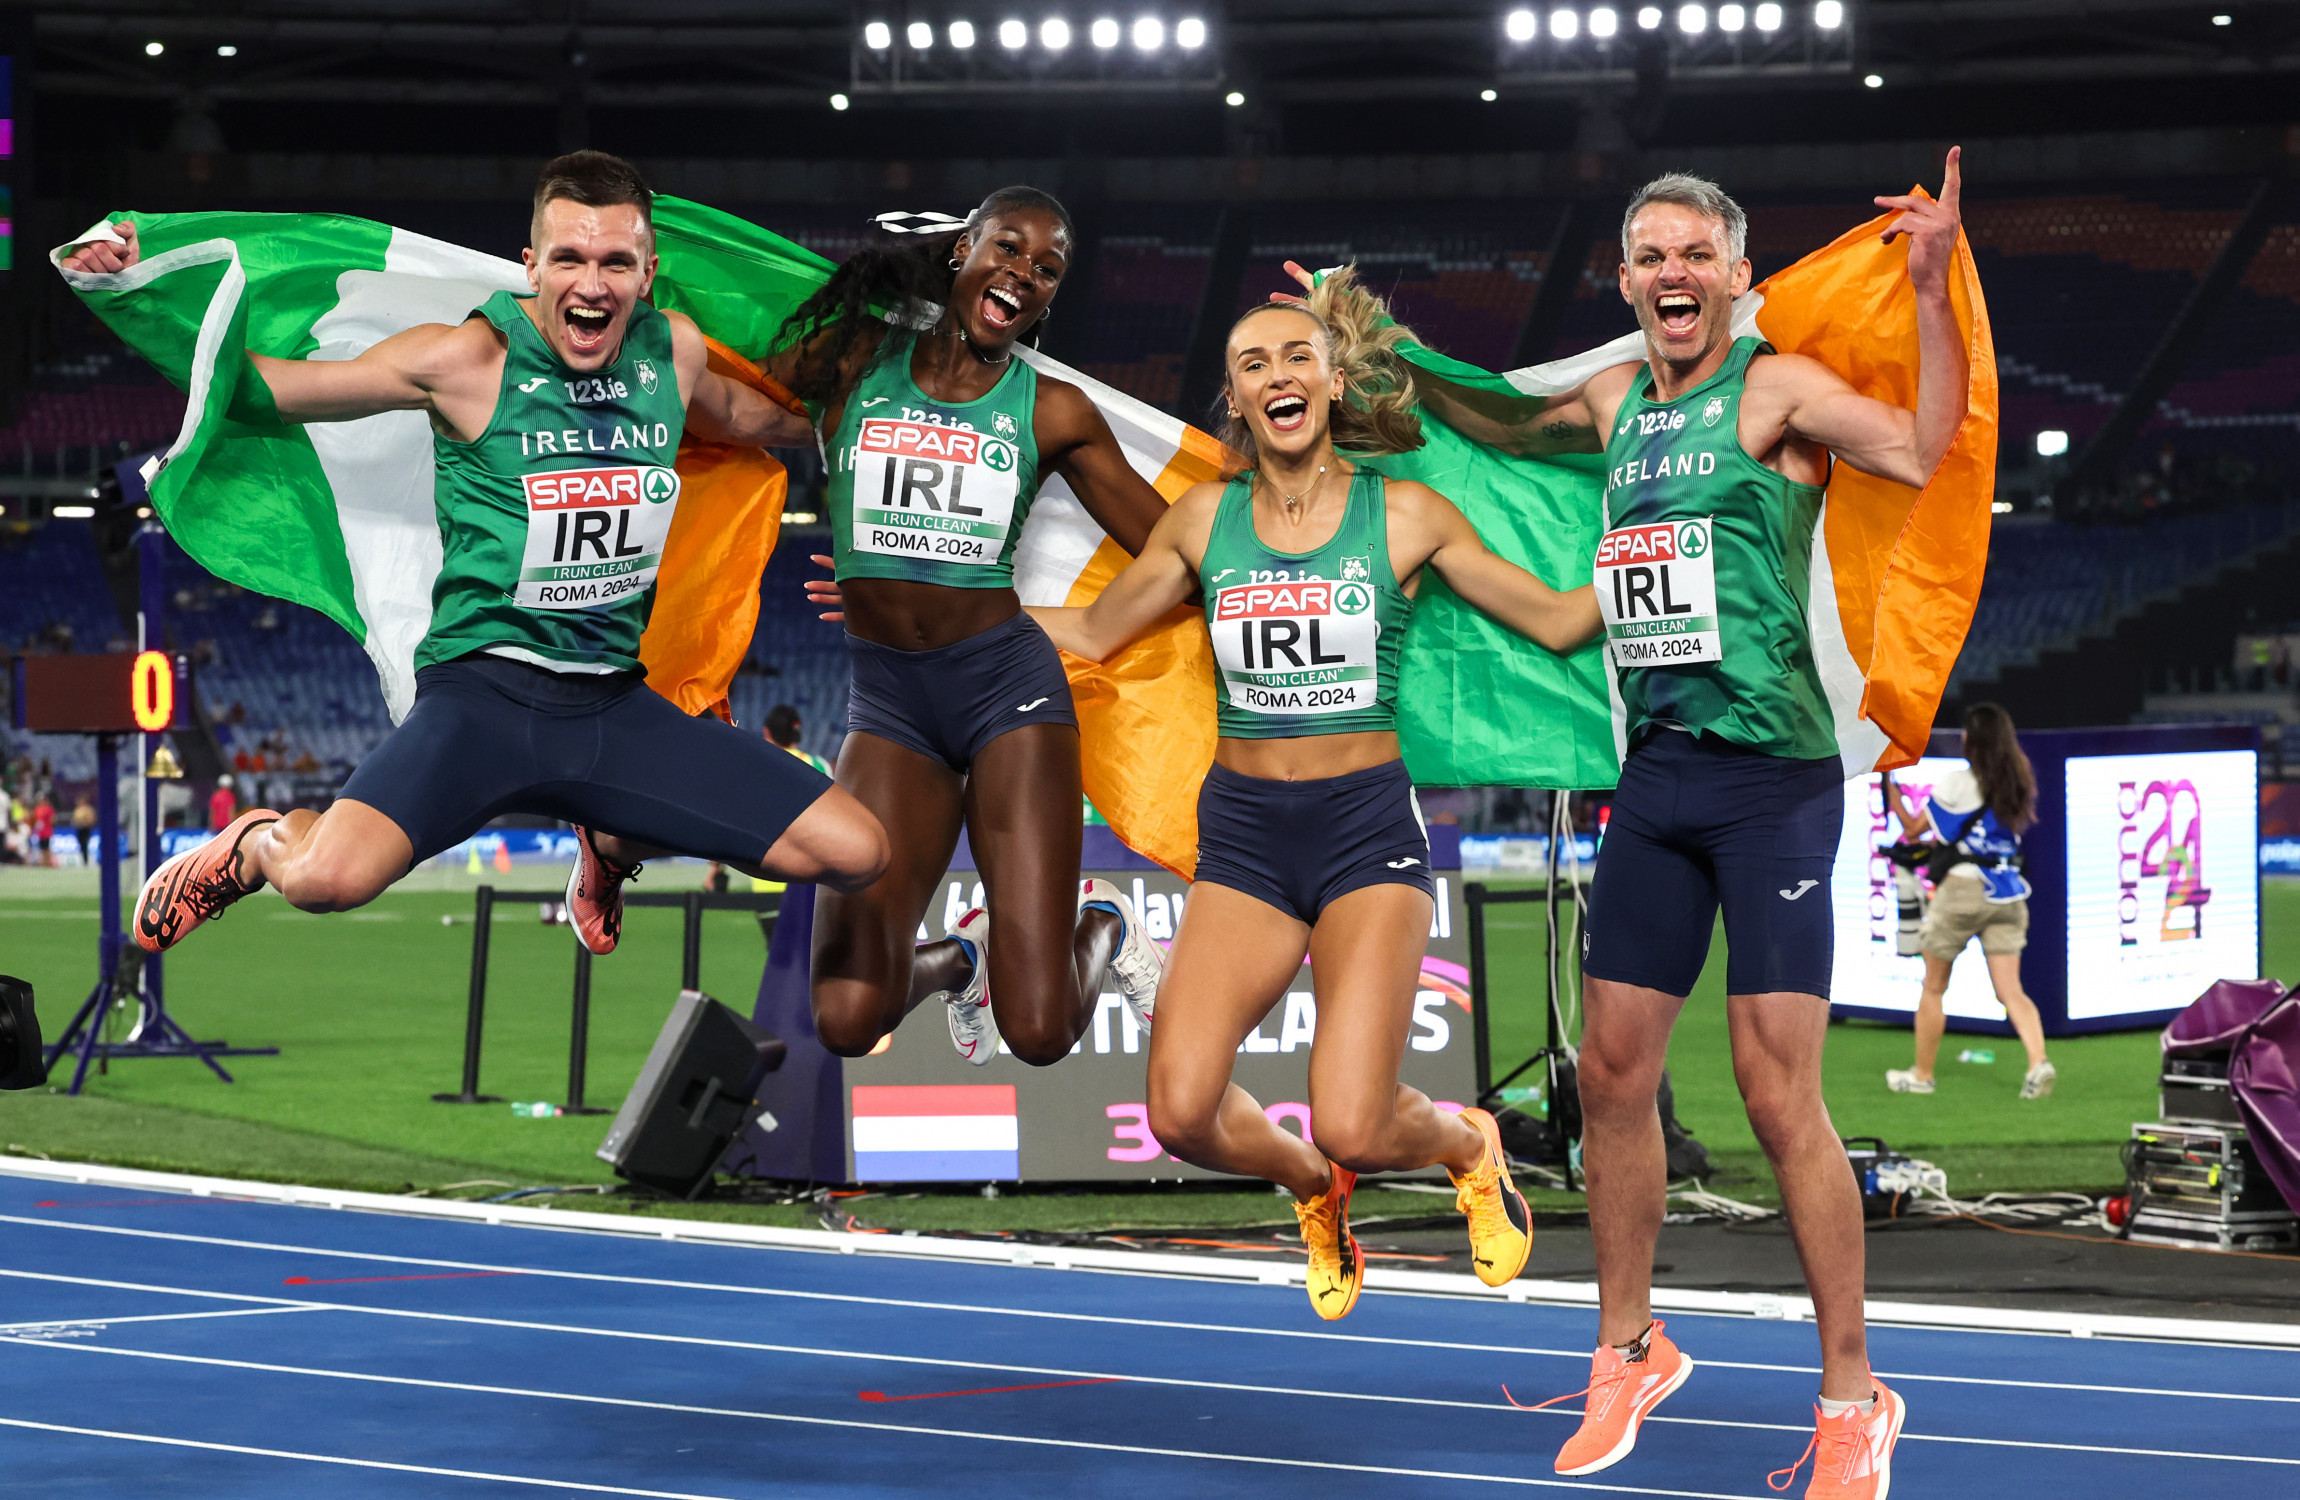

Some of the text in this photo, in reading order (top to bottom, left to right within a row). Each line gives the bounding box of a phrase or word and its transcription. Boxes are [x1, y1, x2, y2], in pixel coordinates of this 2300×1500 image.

[564, 377, 629, 403] 123.ie
[1637, 409, 1686, 436] 123.ie
[521, 423, 669, 455] IRELAND
[865, 425, 976, 460] SPAR
[882, 456, 983, 517] IRL
[1608, 452, 1716, 493] IRELAND
[531, 474, 638, 505] SPAR
[883, 512, 888, 524] I
[890, 513, 923, 528] RUN
[553, 509, 643, 562] IRL
[872, 530, 983, 558] ROMA 2024
[1598, 530, 1674, 563] SPAR
[553, 568, 558, 579] I
[560, 566, 591, 578] RUN
[539, 575, 640, 602] ROMA 2024
[1221, 587, 1328, 616] SPAR
[1612, 564, 1692, 620] IRL
[1242, 619, 1346, 669] IRL
[1626, 623, 1648, 636] RUN
[1622, 638, 1702, 660] ROMA 2024
[132, 651, 173, 731] 0
[1257, 674, 1287, 686] RUN
[1246, 686, 1356, 708] ROMA 2024
